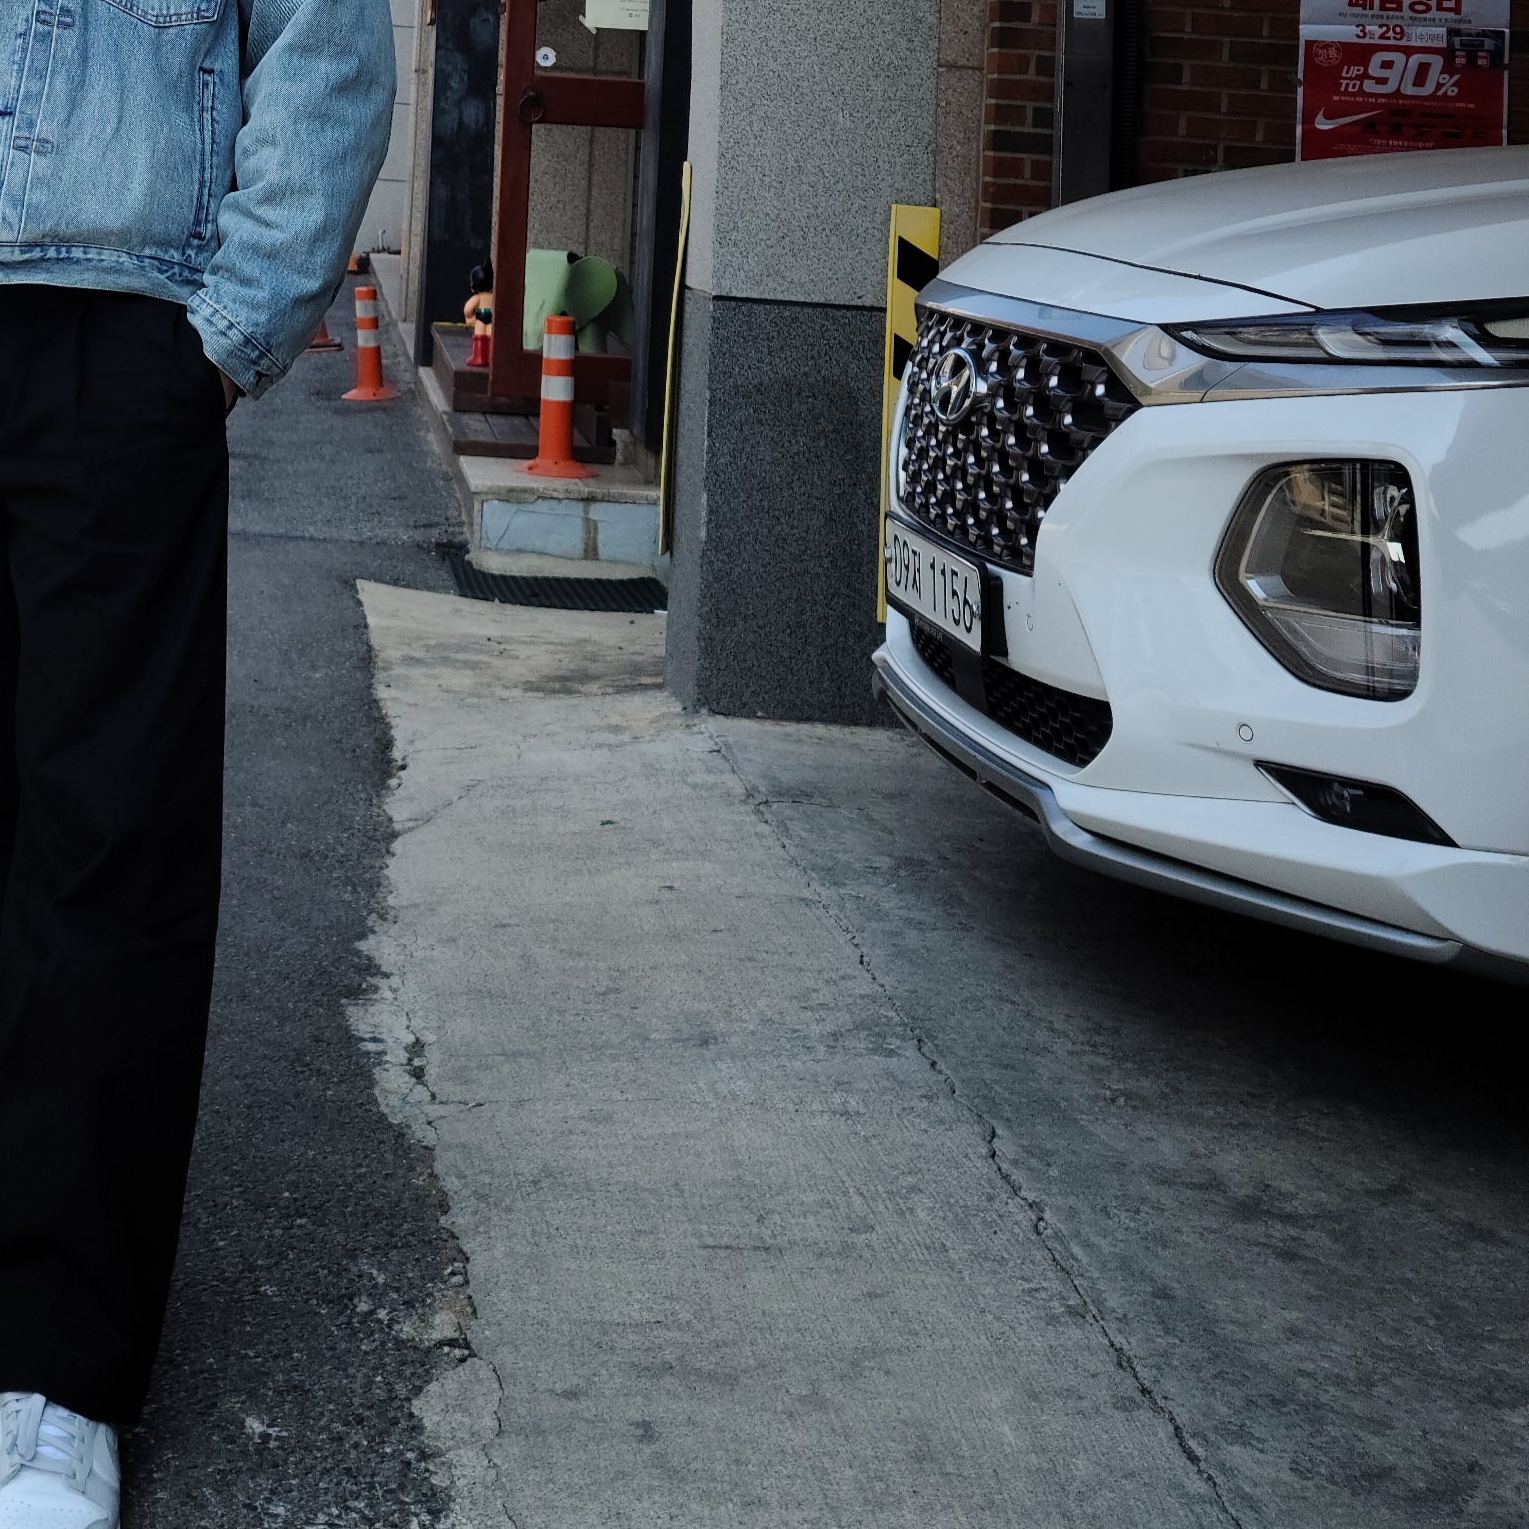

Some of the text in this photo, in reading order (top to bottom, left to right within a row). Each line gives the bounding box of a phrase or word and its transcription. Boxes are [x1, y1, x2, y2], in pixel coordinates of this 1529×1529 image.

[1355, 24, 1376, 40] 3월
[1378, 24, 1413, 43] 29일
[1342, 65, 1364, 78] UP
[1363, 51, 1461, 96] 90%
[1339, 79, 1360, 93] TO
[893, 533, 974, 634] 09저 1156
